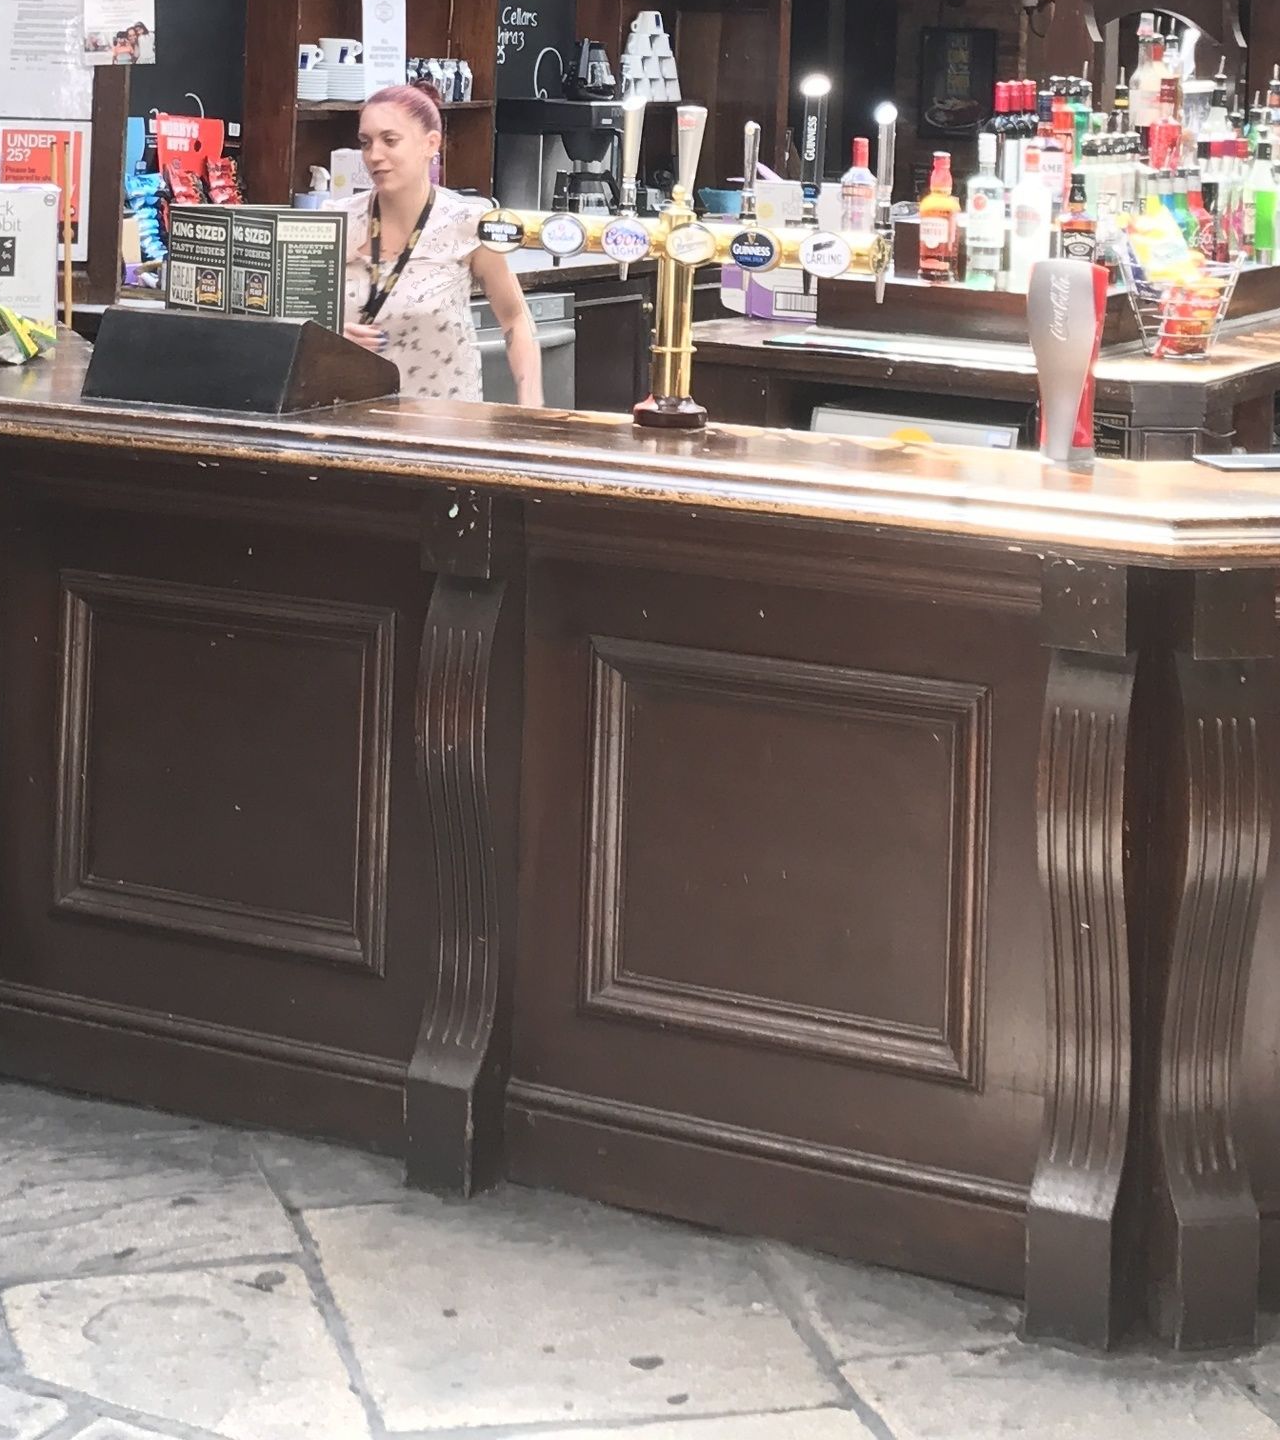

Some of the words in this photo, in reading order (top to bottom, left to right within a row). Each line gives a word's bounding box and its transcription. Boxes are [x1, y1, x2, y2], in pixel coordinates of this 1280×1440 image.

[502, 6, 538, 27] Cellars
[803, 114, 818, 162] GUINNESS
[6, 148, 32, 162] 25?
[171, 220, 195, 241] KING
[195, 223, 227, 242] SIZED
[244, 227, 272, 245] SIZED
[282, 224, 332, 234] SNACKS
[604, 228, 648, 248] Coors
[171, 242, 194, 254] TASTY
[195, 244, 226, 258] DISHES
[244, 248, 271, 261] DISHES
[611, 247, 641, 257] LIGHT
[732, 242, 771, 257] GUINNESS
[806, 252, 843, 266] CARLING
[172, 264, 195, 288] GREAT
[171, 285, 193, 304] VALUE
